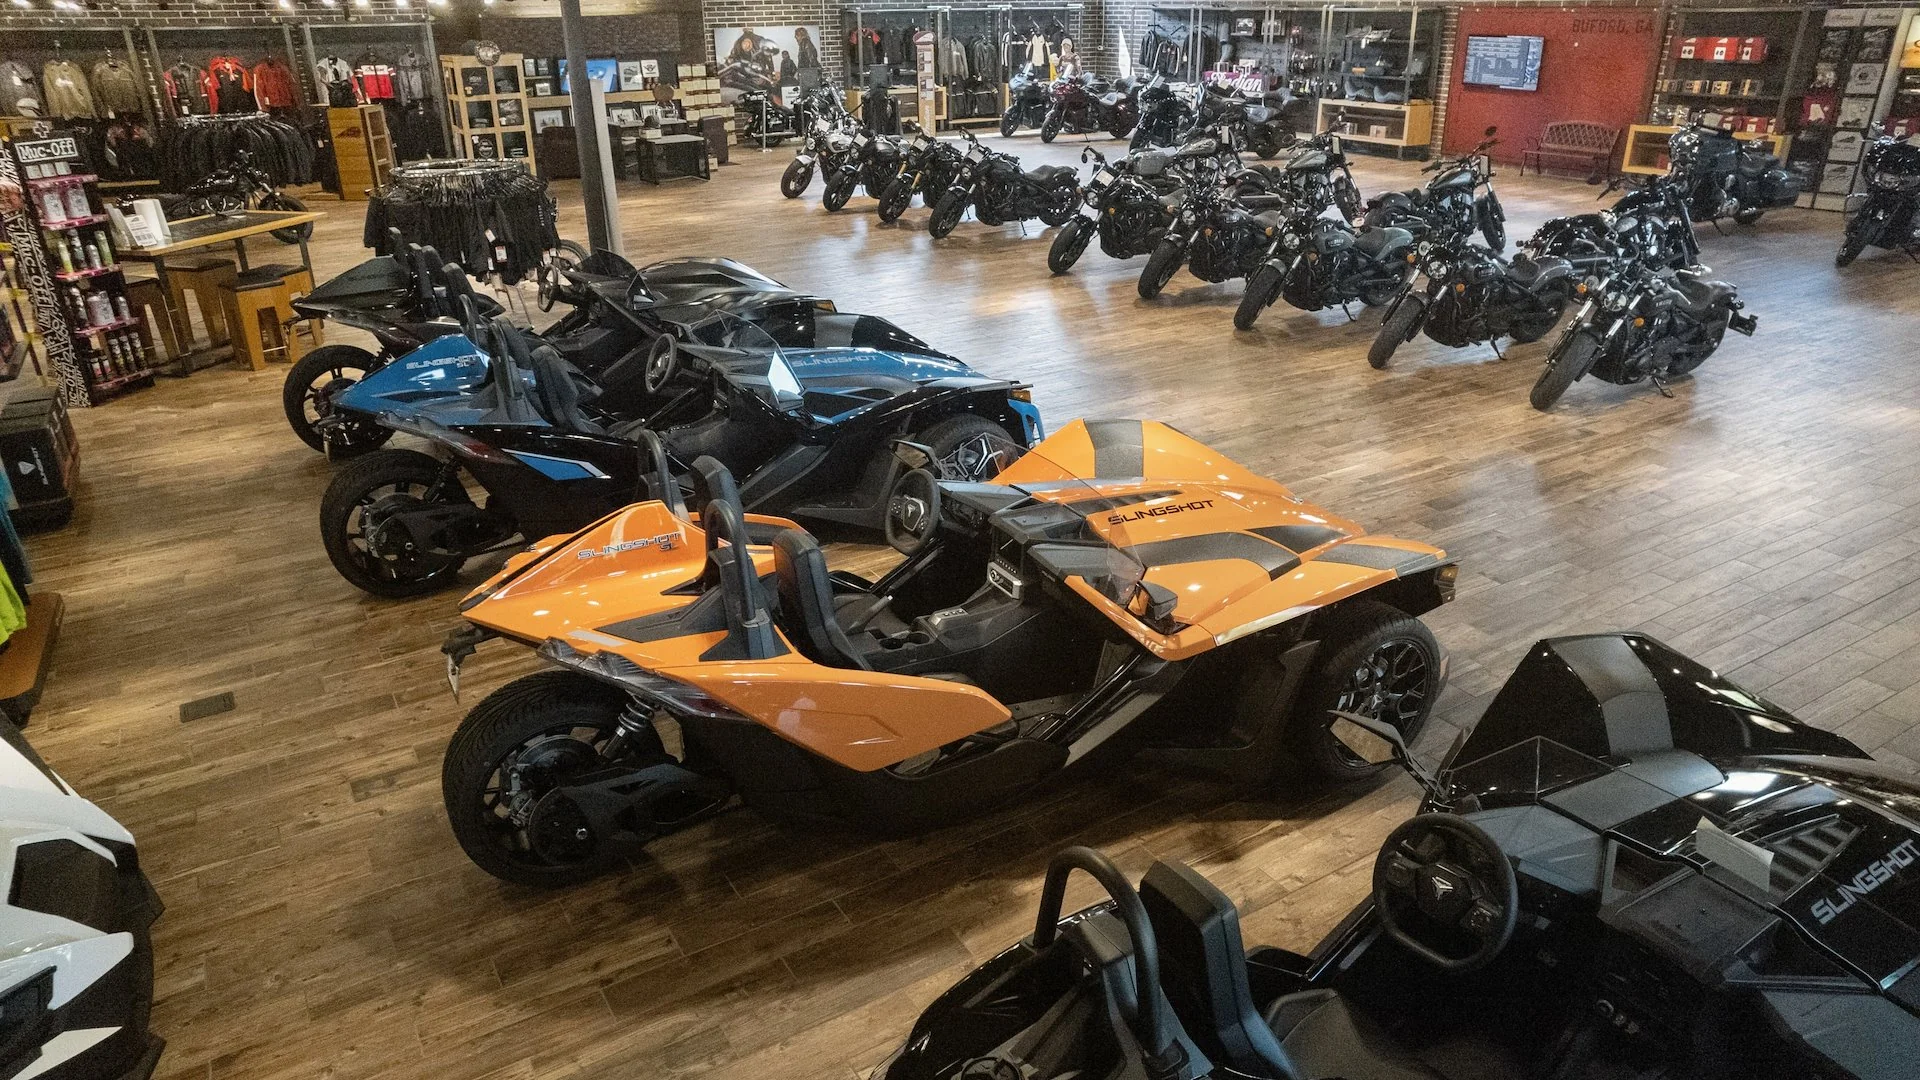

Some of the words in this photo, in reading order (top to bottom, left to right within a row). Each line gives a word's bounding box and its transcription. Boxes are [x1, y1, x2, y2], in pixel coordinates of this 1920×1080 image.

[19, 140, 75, 160] Muc-Off
[791, 355, 878, 367] SLINGSHOT
[1108, 499, 1214, 525] SLINGSHOT
[577, 531, 682, 560] SLINGSHOT
[1810, 838, 1920, 925] SLINGSHOT
